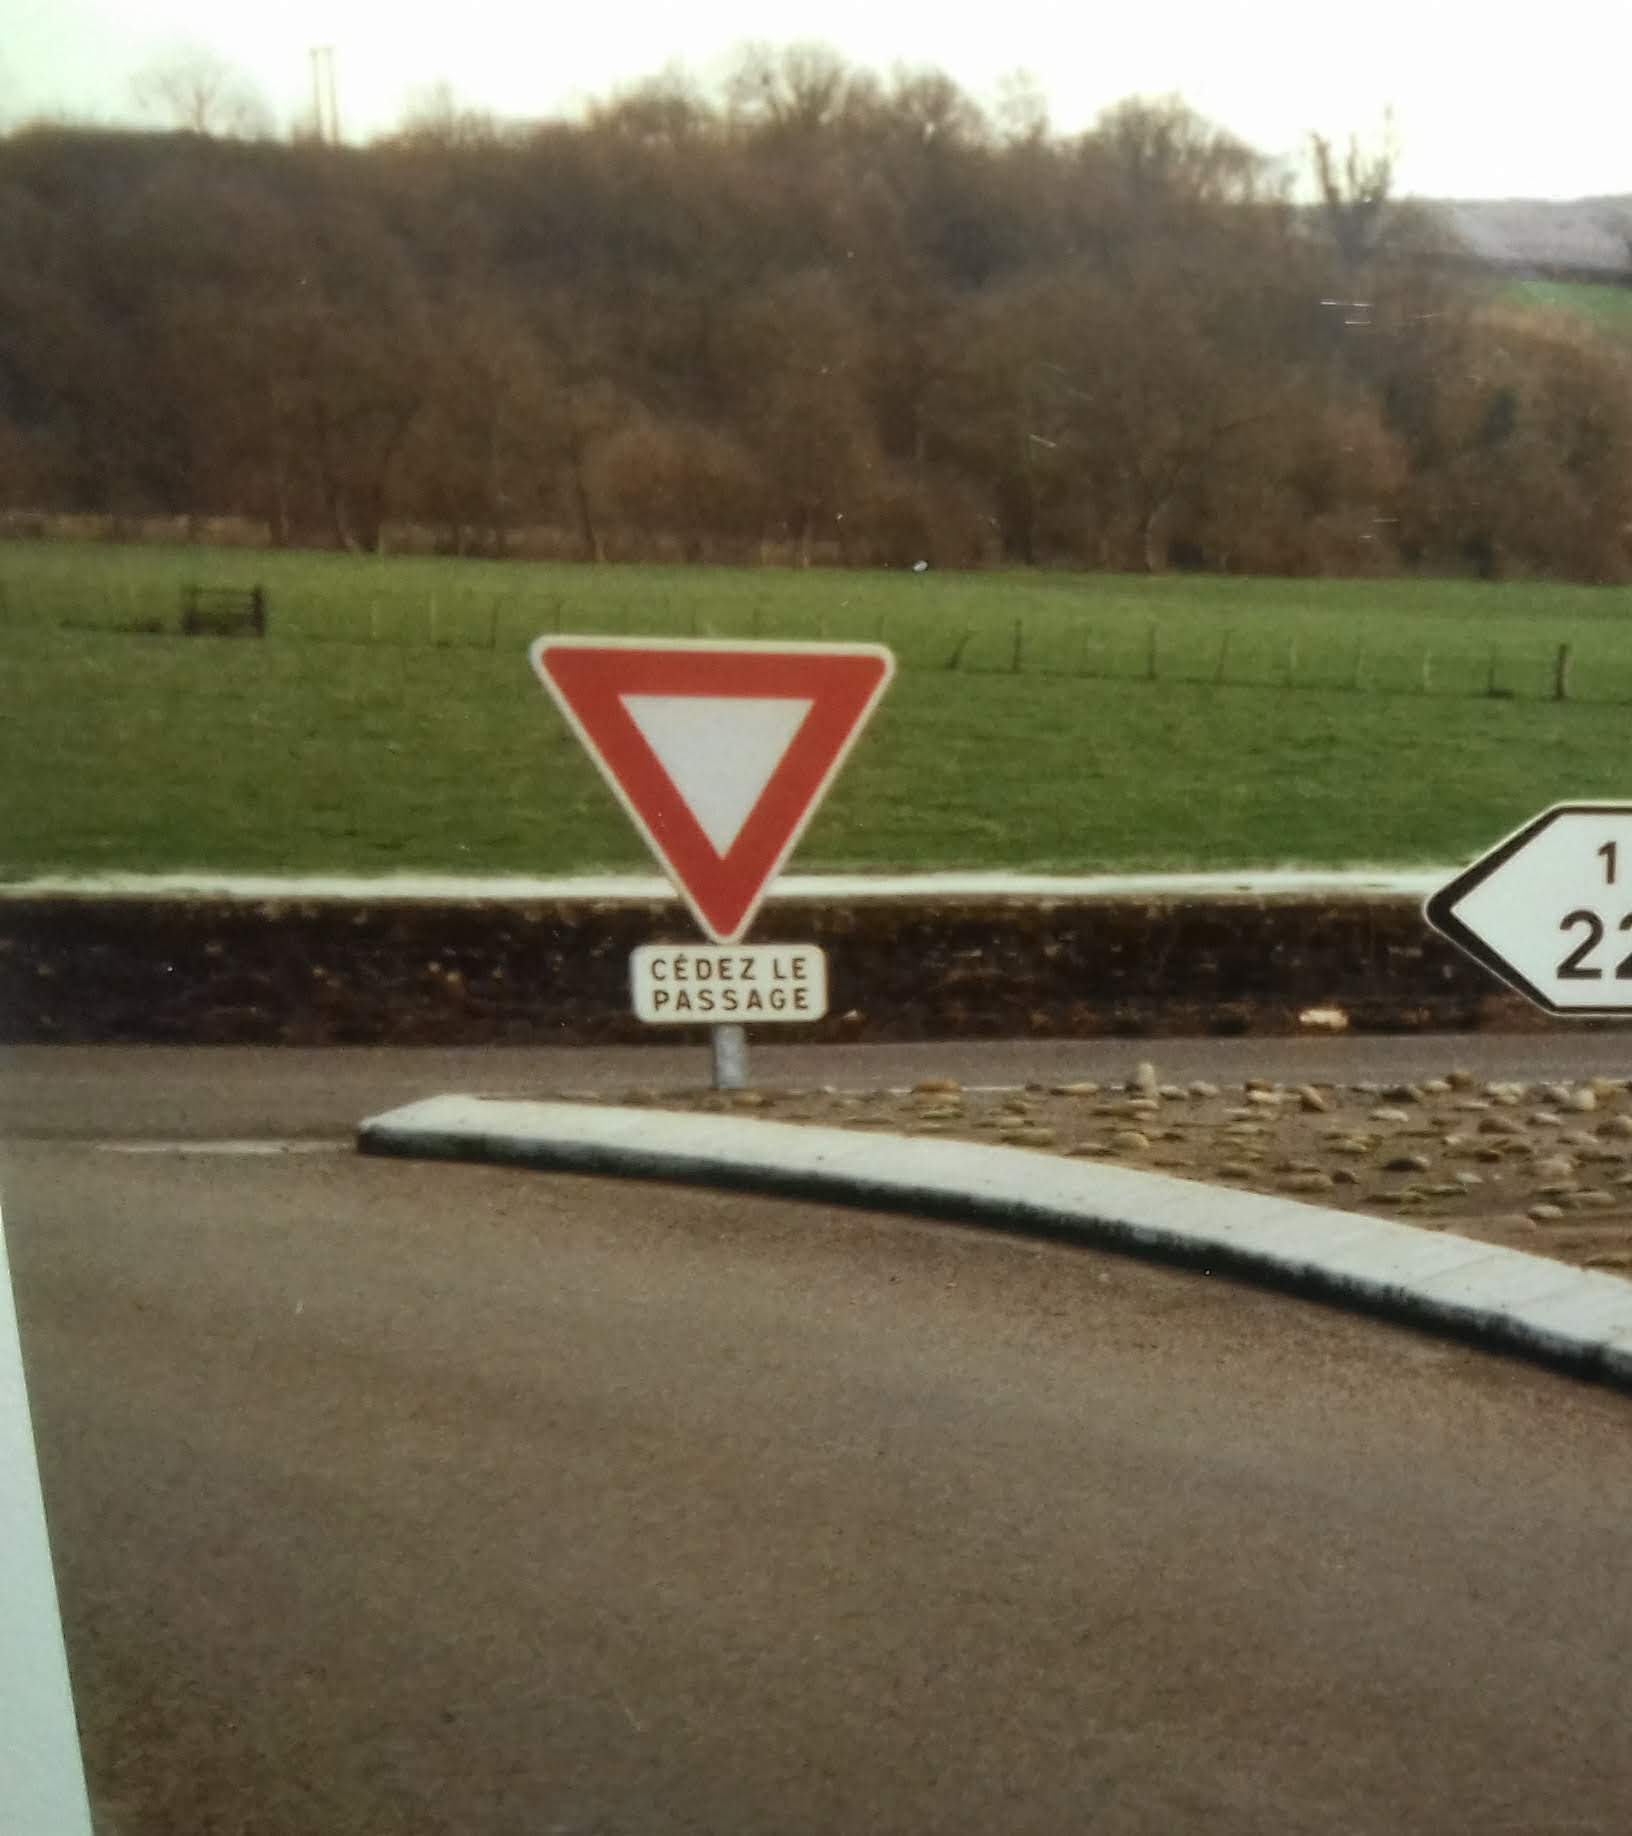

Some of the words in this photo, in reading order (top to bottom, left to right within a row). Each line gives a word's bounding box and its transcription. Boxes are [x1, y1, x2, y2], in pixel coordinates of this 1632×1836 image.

[1597, 841, 1617, 884] 1
[651, 955, 756, 980] CÉDEZ
[773, 958, 808, 979] LE
[653, 989, 809, 1011] PASSAGE
